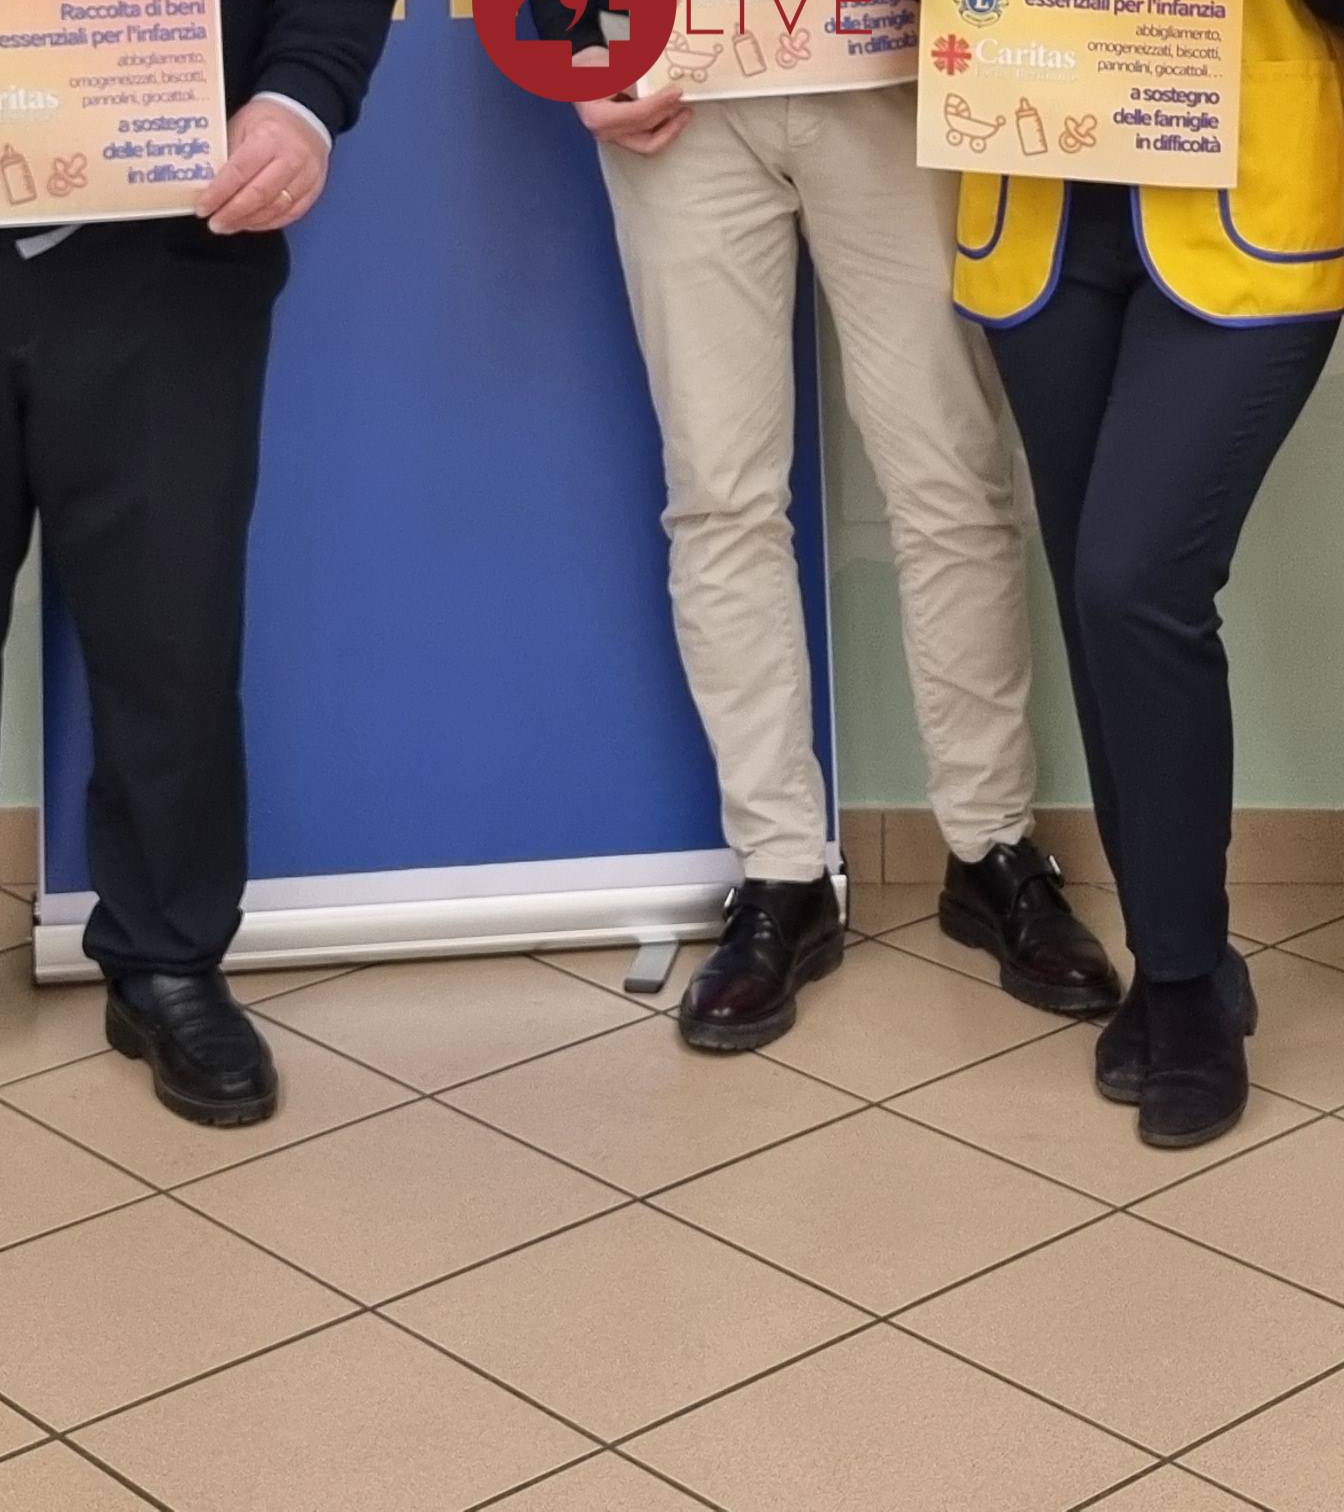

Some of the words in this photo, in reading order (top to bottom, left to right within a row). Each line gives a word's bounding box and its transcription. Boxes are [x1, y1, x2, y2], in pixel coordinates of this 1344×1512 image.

[60, 0, 141, 20] Raccolta
[91, 29, 124, 49] per
[1135, 23, 1220, 42] abbigliamento,
[975, 38, 1074, 67] Caritas
[1087, 41, 1173, 58] omogeneizzati,
[1176, 44, 1219, 61] biscotti,
[1097, 59, 1153, 74] pannolini,
[1129, 86, 1141, 100] a
[1143, 86, 1219, 108] sostegno
[118, 119, 129, 133] a
[131, 114, 209, 134] sostegno
[1112, 107, 1151, 126] delle
[1153, 109, 1218, 132] famiglie
[102, 140, 143, 159] delle
[144, 137, 211, 159] famiglie
[1135, 133, 1154, 150] in
[1154, 133, 1220, 154] difficoltà
[127, 167, 148, 183] in
[147, 162, 215, 182] difficoltà
